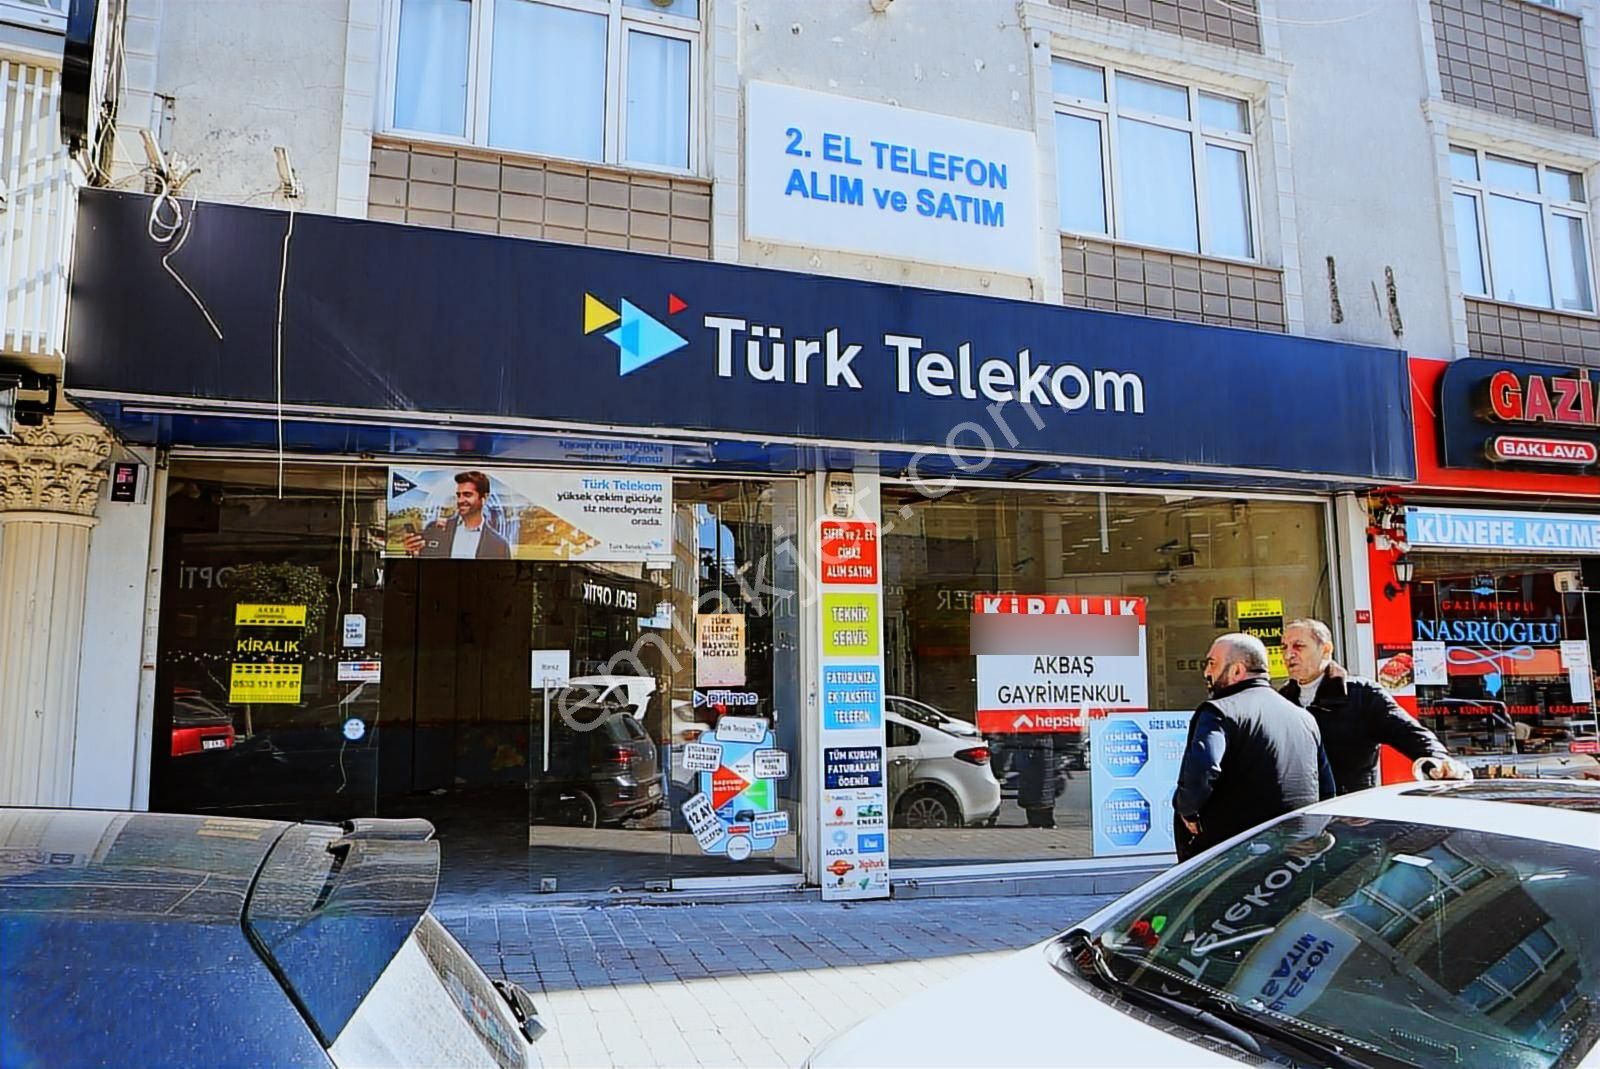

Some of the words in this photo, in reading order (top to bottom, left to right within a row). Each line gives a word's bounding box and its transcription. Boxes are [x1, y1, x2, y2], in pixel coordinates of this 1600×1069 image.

[785, 128, 812, 157] 2.
[823, 133, 863, 165] EL
[871, 140, 1007, 189] TELEFON
[785, 169, 864, 207] ALIM
[873, 187, 907, 213] ve
[916, 188, 1005, 228] SATIM
[704, 314, 864, 390] Türk
[883, 332, 1144, 414] Telekom
[1490, 368, 1600, 427] GAZİ
[1502, 441, 1589, 459] BAKLAVA
[582, 479, 610, 490] Türk
[613, 480, 662, 491] Telekom
[557, 492, 591, 502] yüksek
[594, 492, 623, 502] çekim
[625, 493, 662, 504] gücüyle
[584, 504, 597, 513] siz
[599, 505, 662, 515] neredeyseniz
[631, 517, 662, 526] orada.
[832, 603, 869, 623] TEKNİK
[833, 627, 868, 646] SERVİS
[1416, 616, 1558, 643] NASRİOĞLU
[237, 637, 299, 653] KİRALIK
[1033, 656, 1095, 677] AKBAŞ
[707, 690, 758, 707] prime
[998, 681, 1131, 704] GAYRİMENKUL
[834, 710, 871, 724] TELEFON
[1149, 717, 1164, 730] SİZE
[829, 749, 846, 760] TÜM
[848, 750, 878, 760] KURUM
[828, 763, 880, 774] FATURALARI
